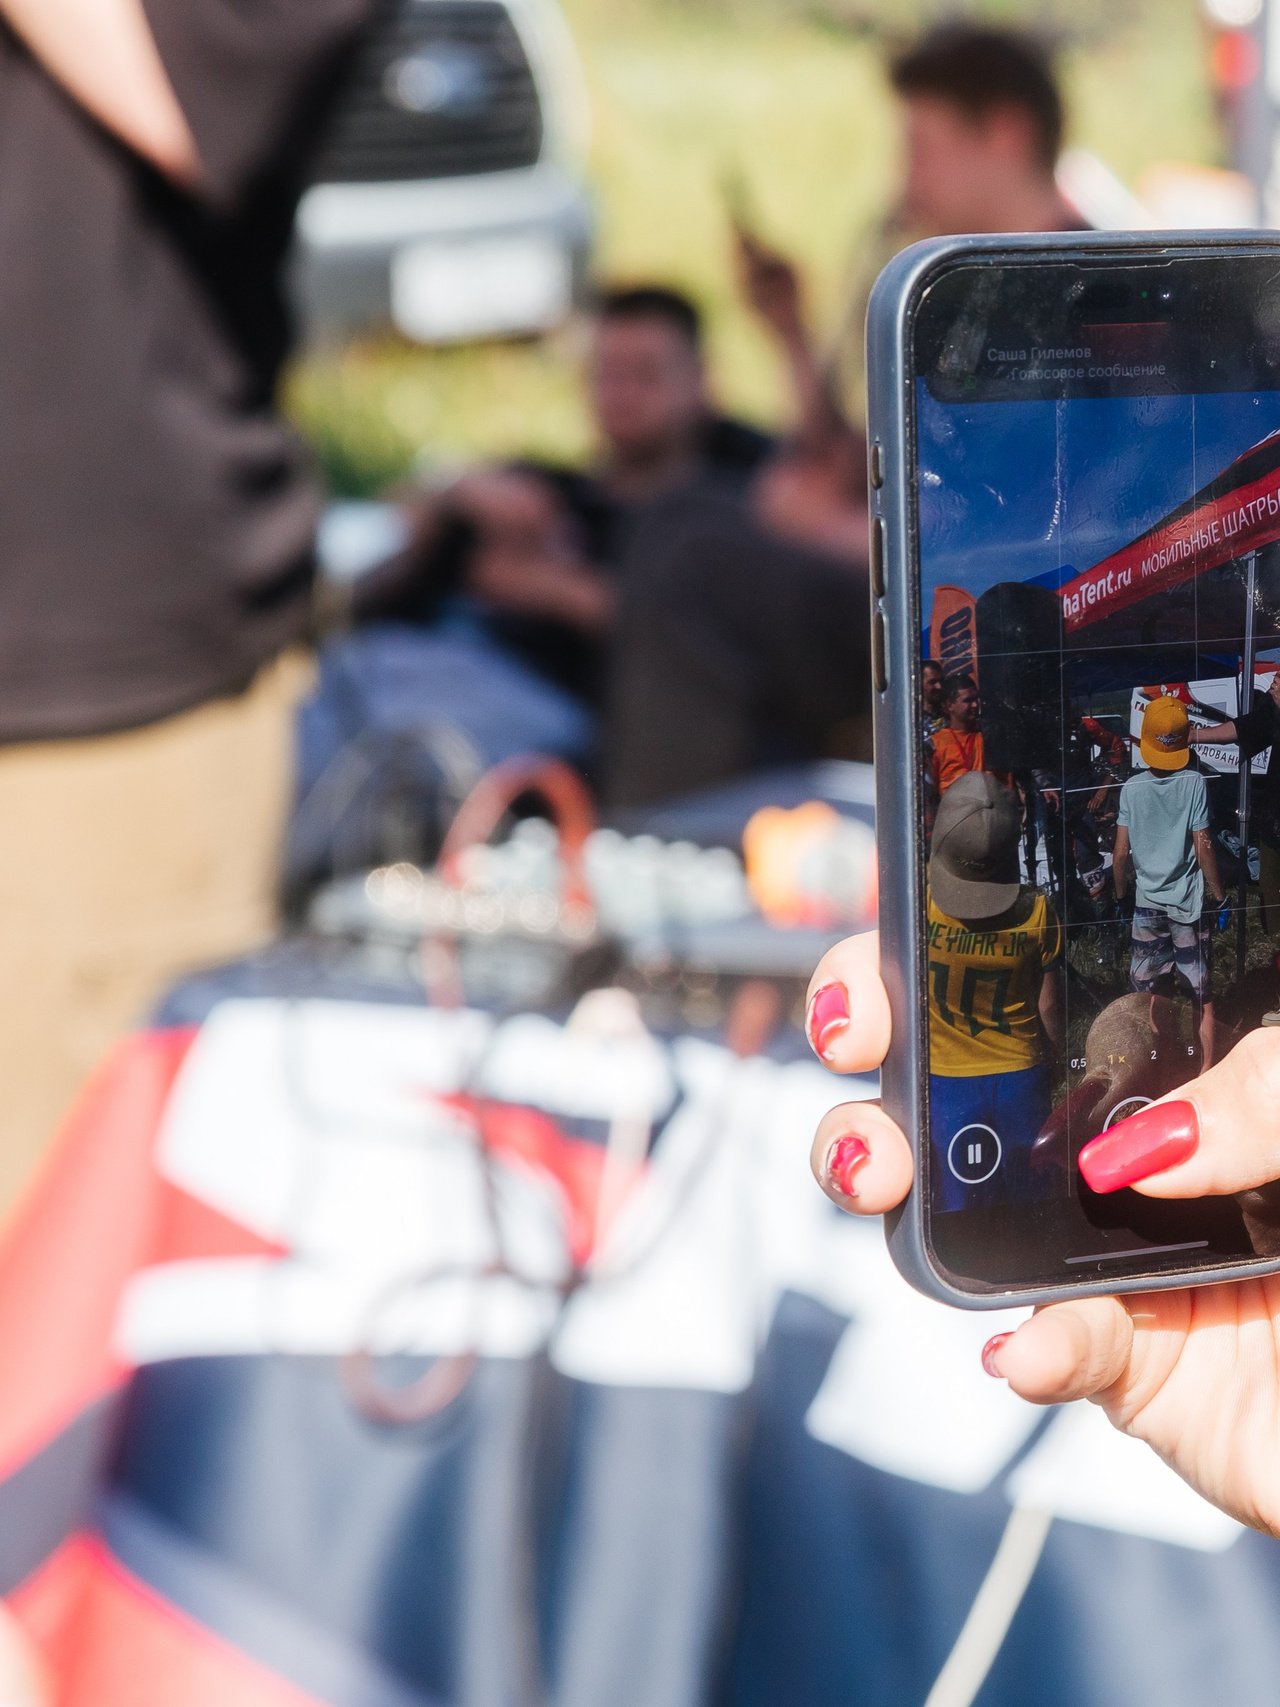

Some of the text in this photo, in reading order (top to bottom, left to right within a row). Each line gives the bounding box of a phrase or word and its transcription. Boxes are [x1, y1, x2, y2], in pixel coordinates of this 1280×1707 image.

[987, 346, 1092, 362] Саша Гилемов
[1011, 362, 1167, 381] Голосовое сообщение
[1141, 520, 1221, 578] МОБИЛЬНЫЕ
[1190, 743, 1240, 766] РУДОВАНИ
[1003, 931, 1028, 957] JR
[929, 961, 1014, 1037] 10
[1070, 1057, 1087, 1070] 0,5
[1150, 1050, 1157, 1060] 2
[1187, 1046, 1194, 1056] 5
